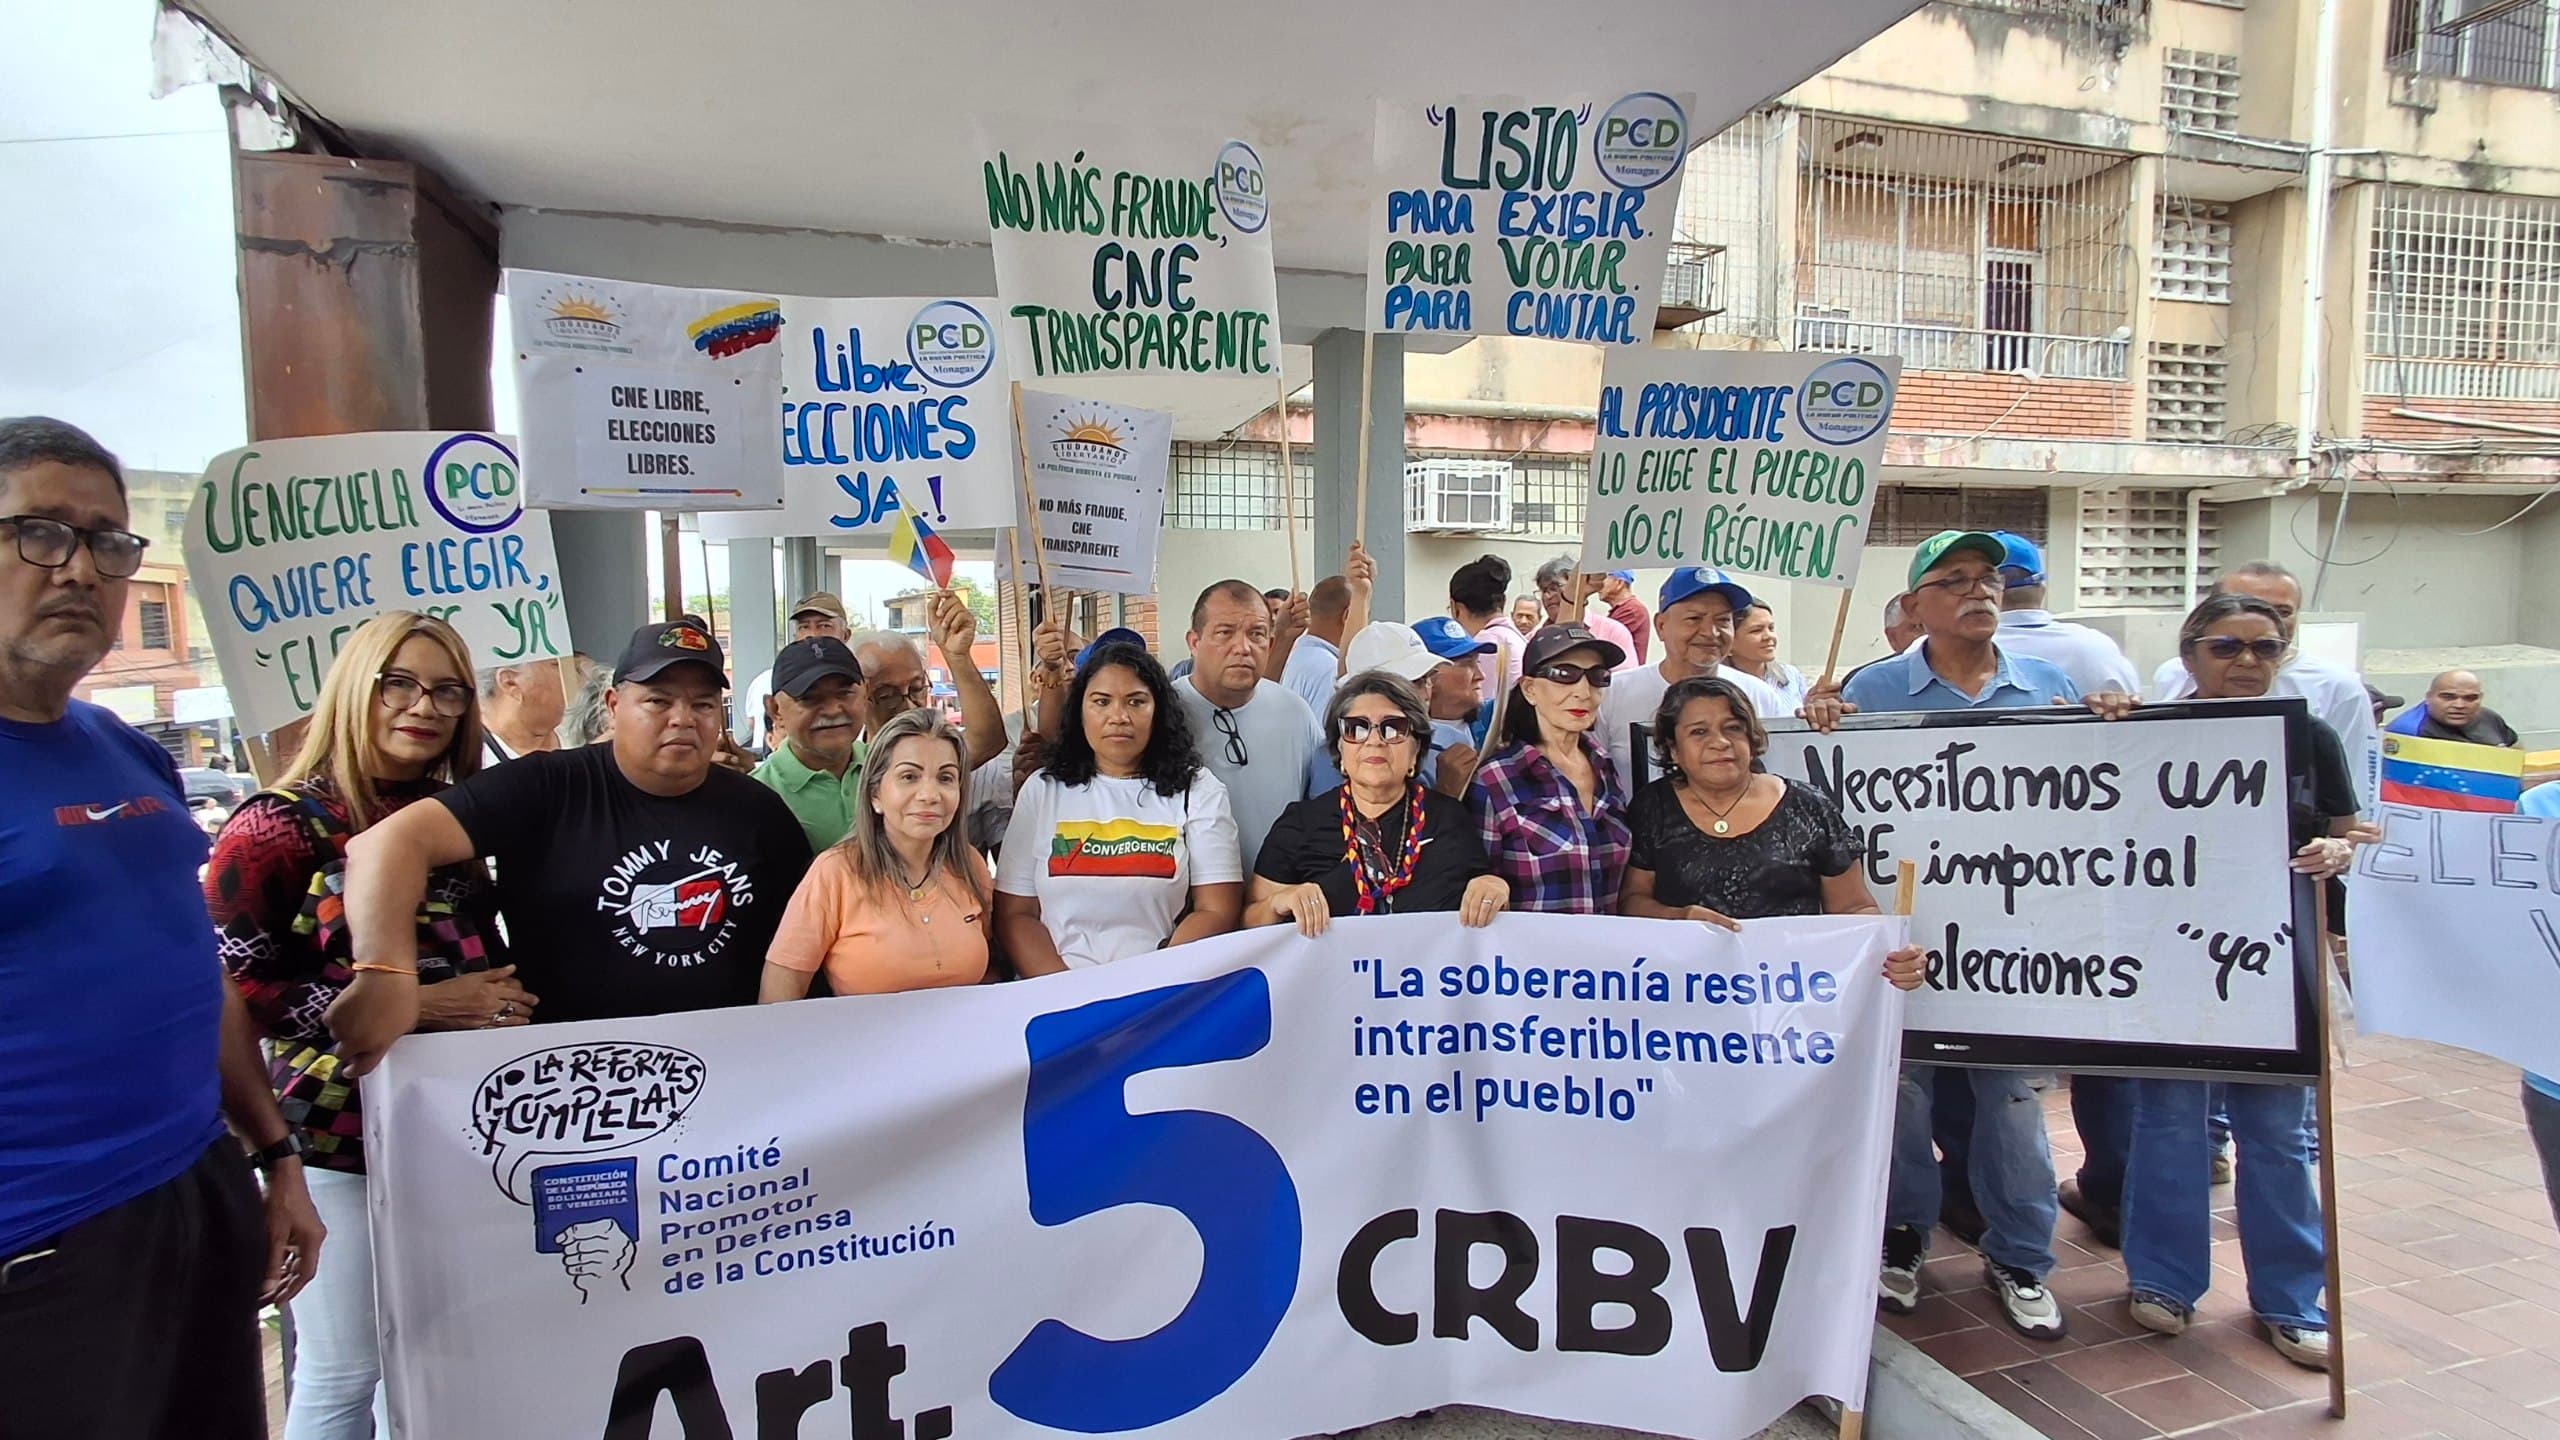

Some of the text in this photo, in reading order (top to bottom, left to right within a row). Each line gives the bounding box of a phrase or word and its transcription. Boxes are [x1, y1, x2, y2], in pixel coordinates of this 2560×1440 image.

[1605, 118, 1679, 147] PCD
[1036, 150, 1105, 236] MÁS
[1111, 171, 1227, 248] FRAUDE,
[1221, 162, 1263, 196] PCD
[1388, 188, 1653, 241] PARA EXIGIR.
[1092, 242, 1199, 312] CNE
[1385, 235, 1639, 294] PARA VOTAR.
[917, 324, 984, 349] PCD
[1385, 285, 1641, 344] PARA CONTAR.
[933, 364, 975, 374] Monagas
[611, 386, 710, 414] CNE LIBRE,
[1598, 382, 1794, 442] AL PRESIDENTE
[1808, 381, 1883, 407] PCD
[608, 419, 716, 444] ELECCIONES
[1053, 443, 1128, 460] CIUDADANOS
[446, 463, 516, 500] PCD
[627, 453, 695, 475] LIBRES.
[1598, 447, 1865, 507] LO ELIGE EL PUEBLO
[202, 452, 419, 553] VENEZUELA
[1039, 498, 1054, 511] NO
[1057, 498, 1082, 515] MÁS
[1042, 537, 1120, 558] TRANSPARENTE
[1071, 521, 1093, 535] CNE
[1607, 502, 1858, 581] NO EL RÉGIMEN.
[229, 535, 550, 632] QUIERE ELEGIR,
[1804, 741, 2121, 813] Necesitamos
[1081, 840, 1175, 856] CONVERGENCIA
[597, 840, 754, 911] TOMMY JEANS
[1921, 835, 2197, 916] imparcial
[612, 919, 737, 967] NEW YORK CITY
[1925, 922, 2142, 998] elecciones
[1353, 955, 1838, 1004] "La soberanía reside
[1353, 1014, 1836, 1065] intransferiblemente
[534, 1053, 564, 1085] LA
[569, 1045, 703, 1094] REFORMES
[1354, 1070, 1654, 1123] en el pueblo"
[544, 1170, 628, 1186] CONSTITUCIÓN
[658, 1137, 781, 1183] Comité
[547, 1189, 627, 1203] BOLIVARIANA
[548, 1196, 628, 1211] DE VENEZUELA
[561, 1185, 574, 1193] LA
[576, 1181, 627, 1192] REPÚBLICA
[603, 967, 1796, 1440] Art. 5 CRBV
[660, 1167, 809, 1214] Nacional
[661, 1193, 818, 1244] Promotor
[662, 1208, 851, 1267] en Defensa
[664, 1220, 955, 1294] de la Constitución
